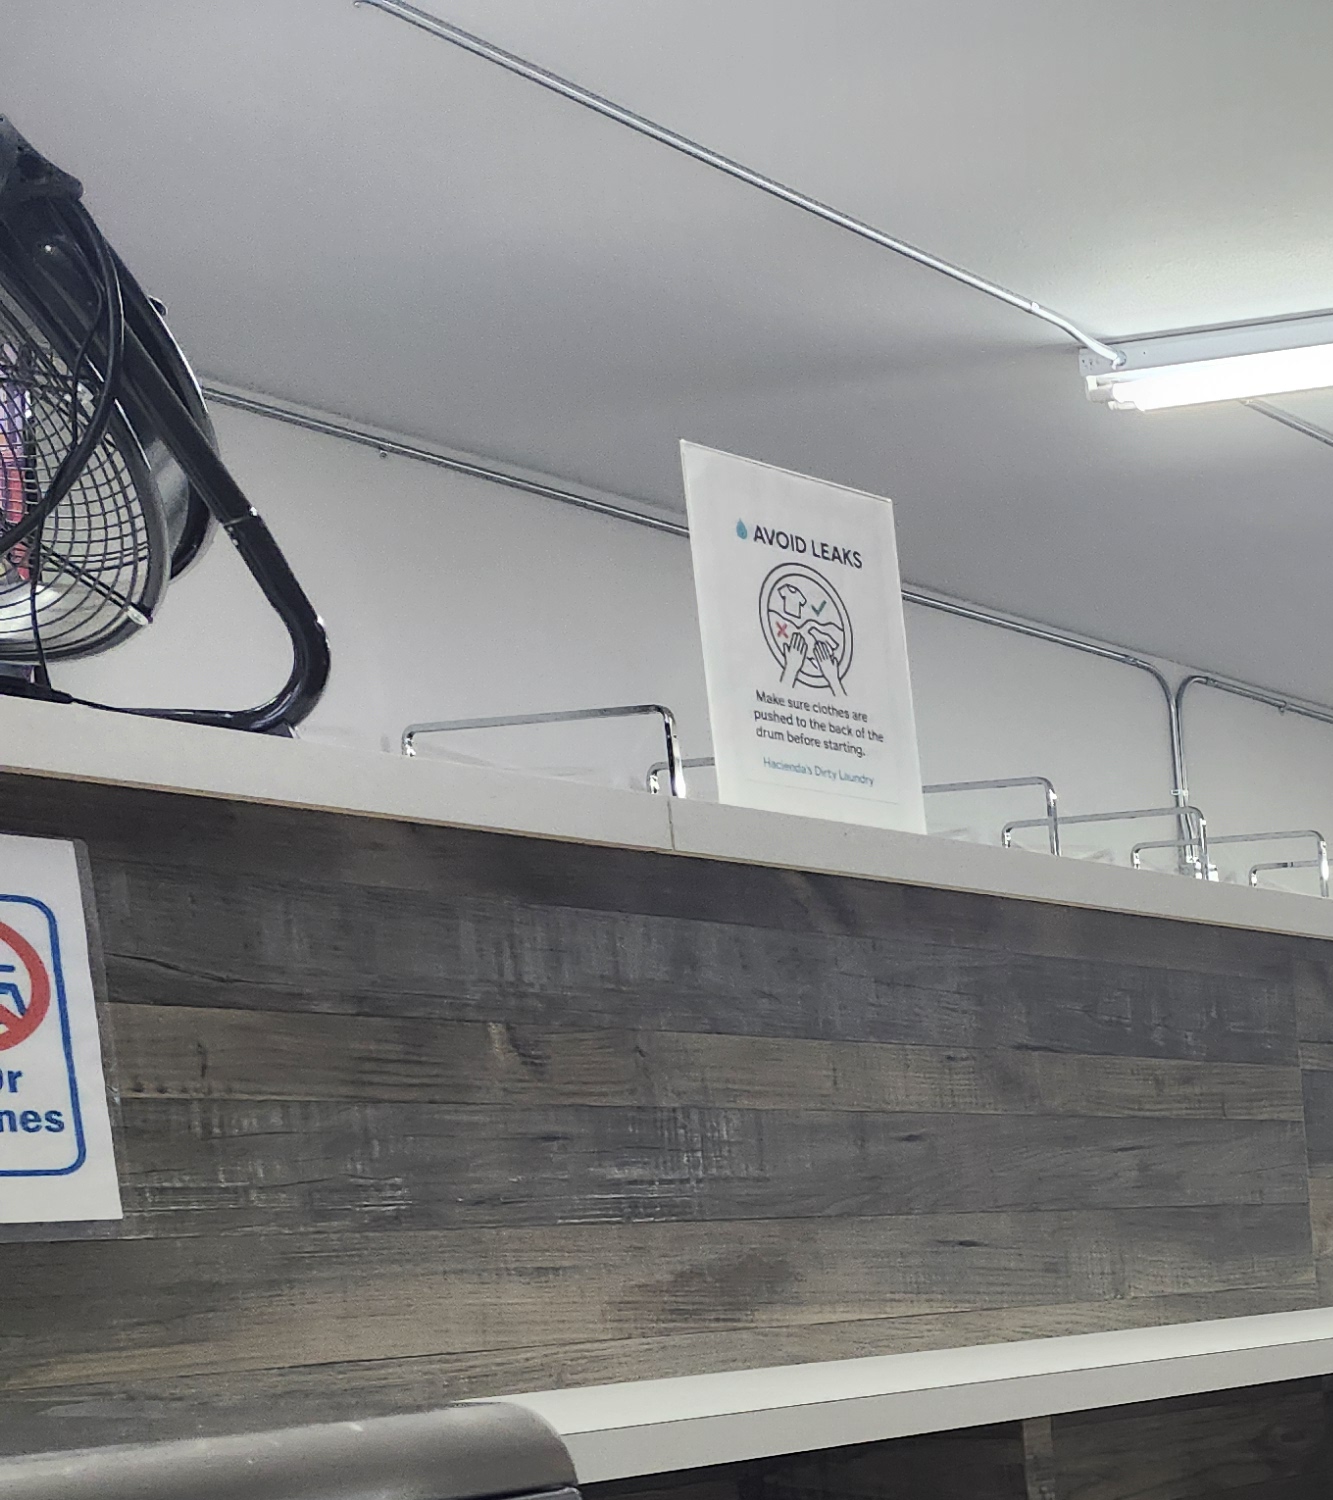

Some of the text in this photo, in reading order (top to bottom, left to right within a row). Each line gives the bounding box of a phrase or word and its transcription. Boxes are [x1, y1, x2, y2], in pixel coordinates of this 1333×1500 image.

[753, 525, 863, 569] AVOID LEAKS
[756, 690, 868, 722] Make sure clothes are
[754, 710, 884, 742] pushed to the back of the
[756, 726, 866, 758] drum before starting.
[763, 757, 874, 787] Hacienda's Dirty Laundry
